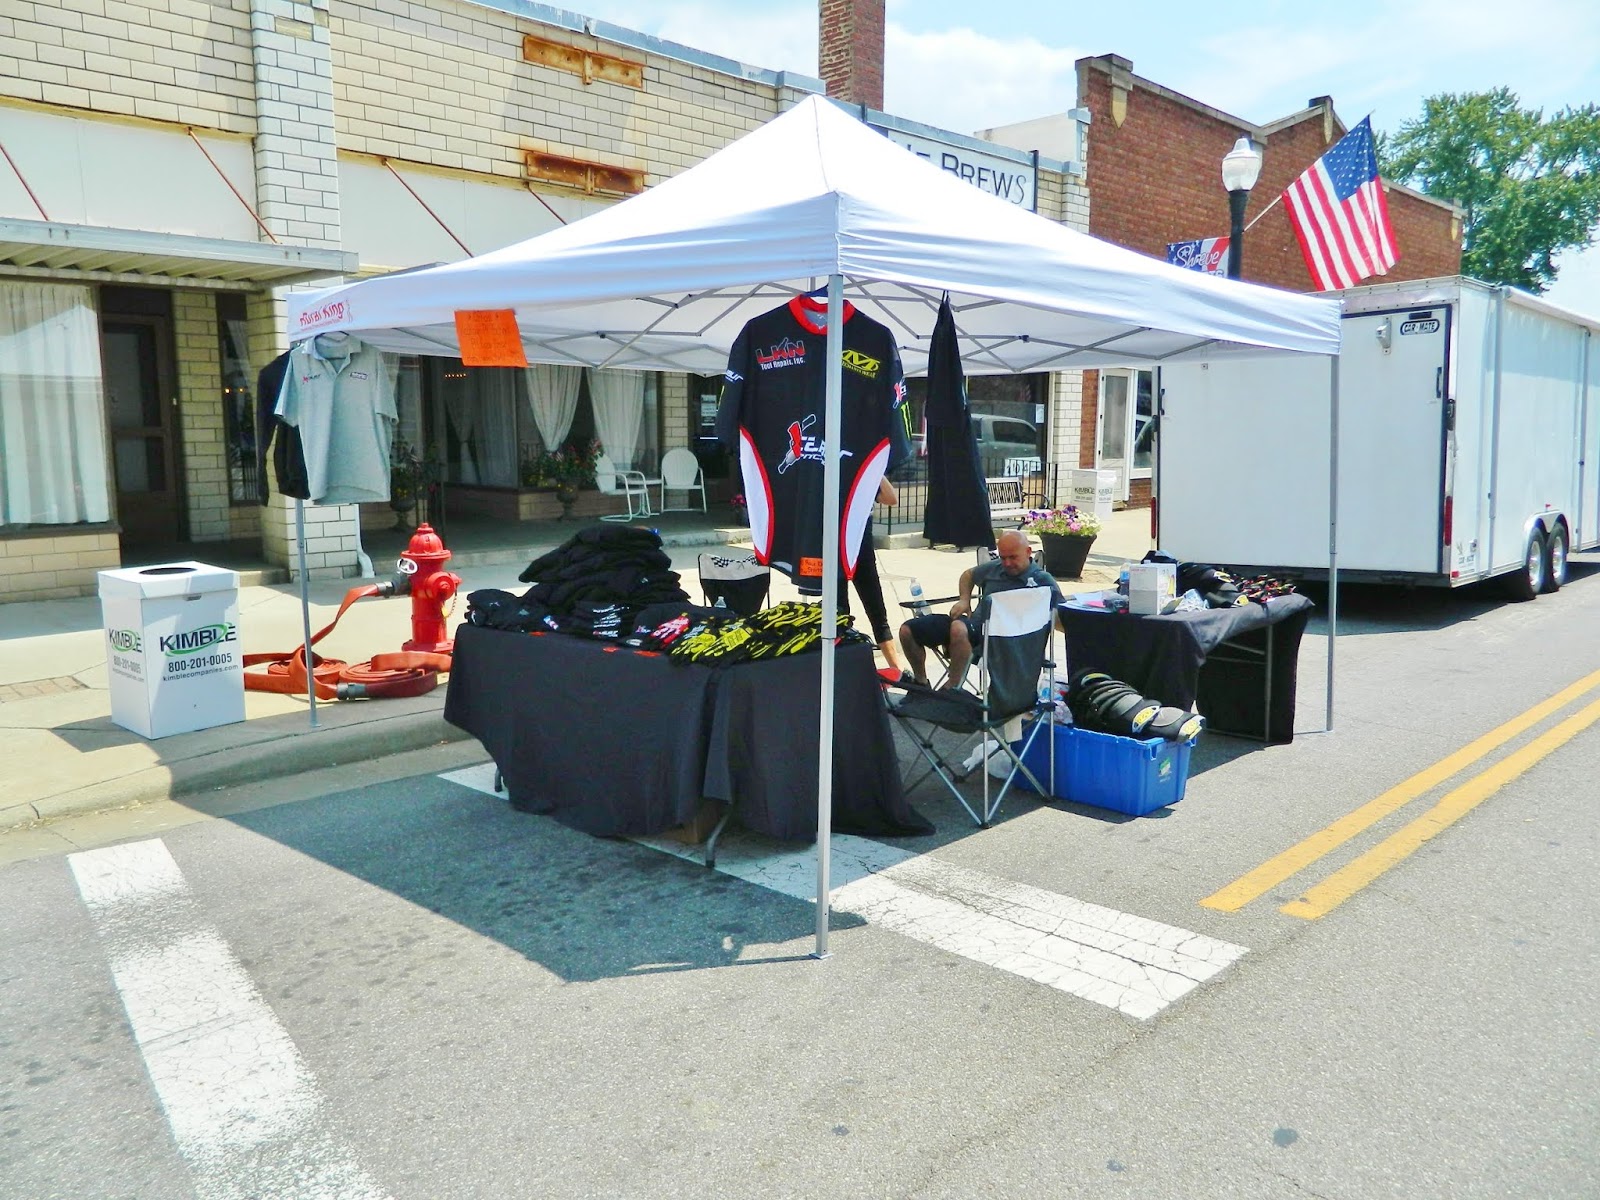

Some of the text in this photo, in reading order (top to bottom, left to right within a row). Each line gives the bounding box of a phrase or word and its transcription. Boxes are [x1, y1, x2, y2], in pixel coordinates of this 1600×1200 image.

[1176, 245, 1220, 269] Shreve
[109, 628, 143, 654] KIMBLE
[160, 625, 237, 653] KIMBLE
[163, 664, 239, 682] kimblecompanies.com
[168, 653, 232, 673] 800-201-0005
